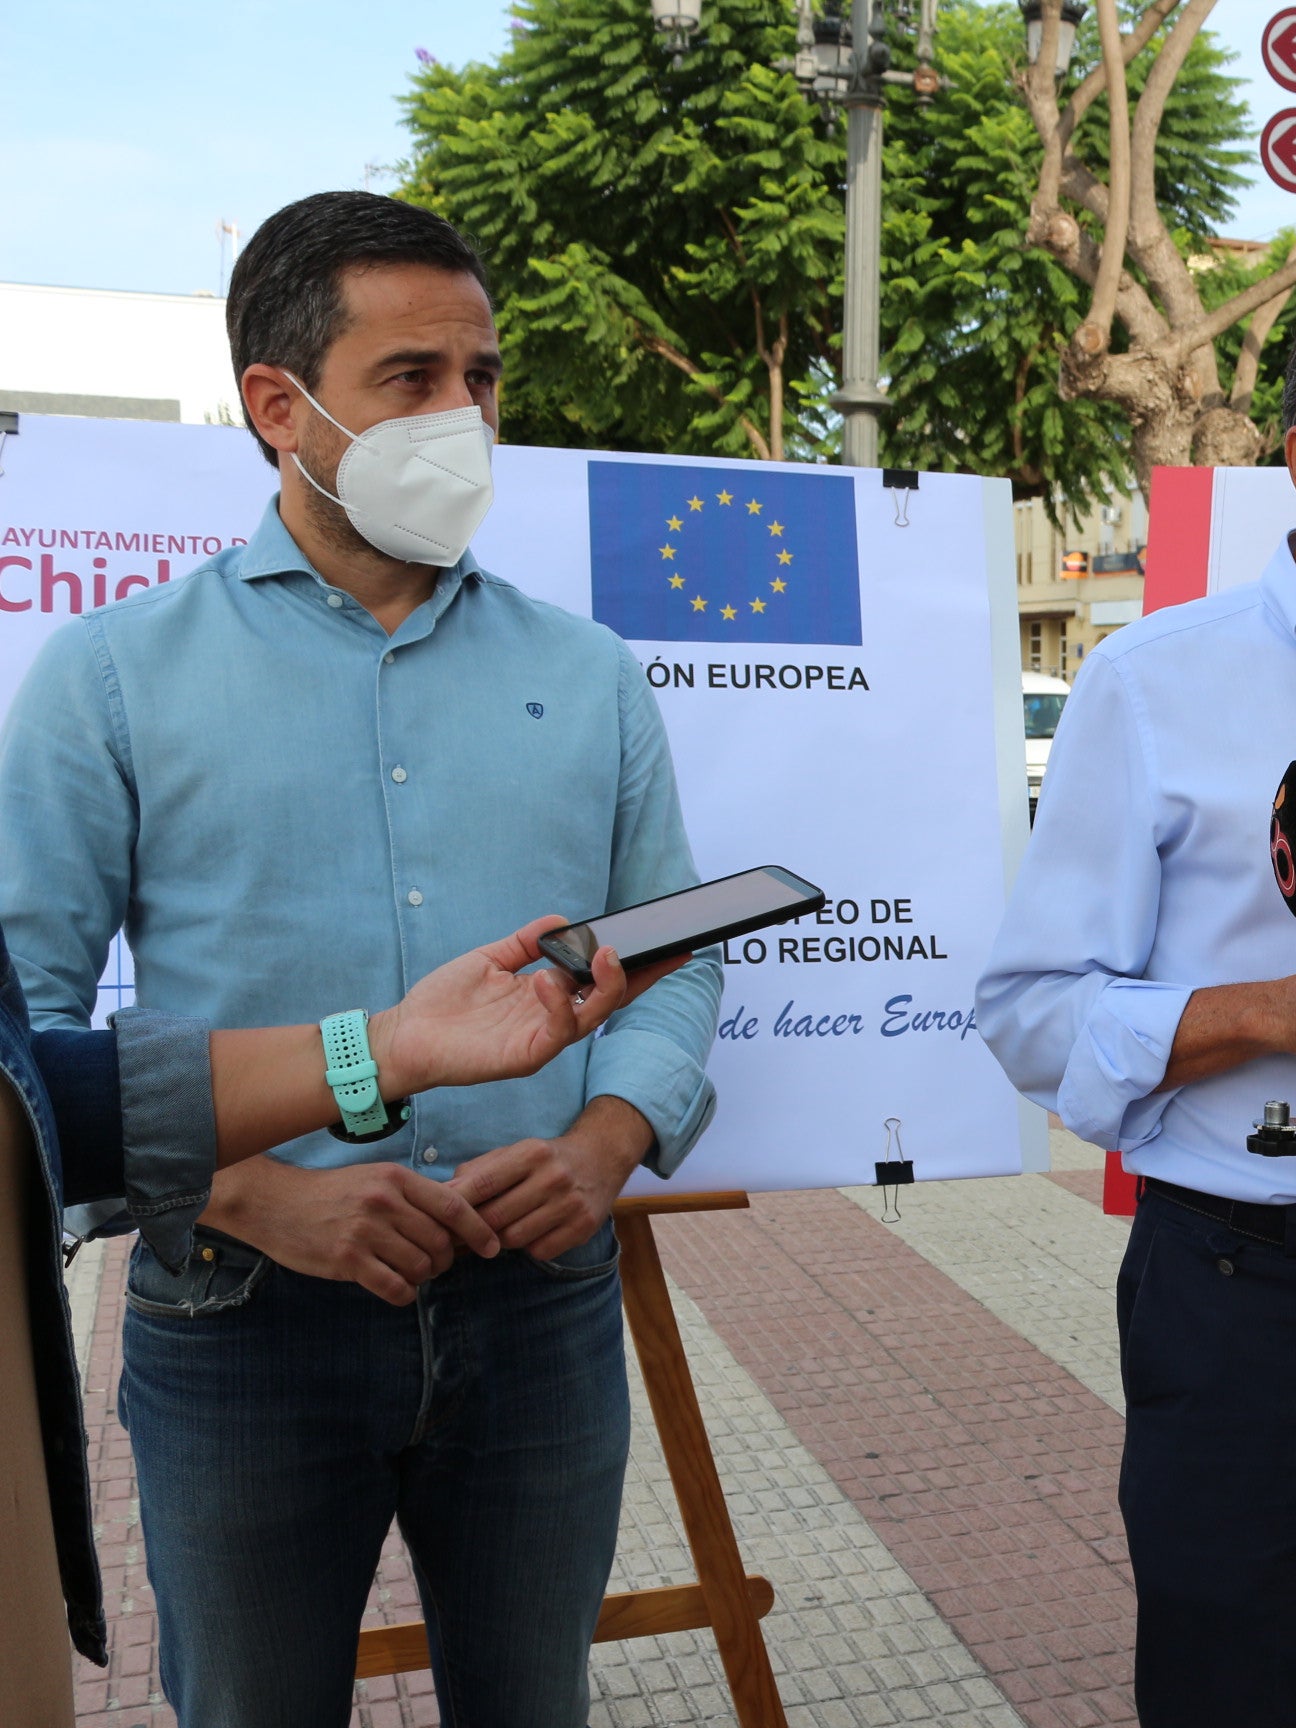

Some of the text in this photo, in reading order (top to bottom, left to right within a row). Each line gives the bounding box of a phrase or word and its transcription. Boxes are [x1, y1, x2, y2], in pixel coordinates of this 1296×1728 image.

[2, 527, 222, 555] AYUNTAMIENTO
[643, 656, 870, 691] ÓN EUROPEA
[870, 899, 913, 924] DE
[723, 935, 948, 965] LO REGIONAL
[718, 994, 978, 1041] de hacer Europ
